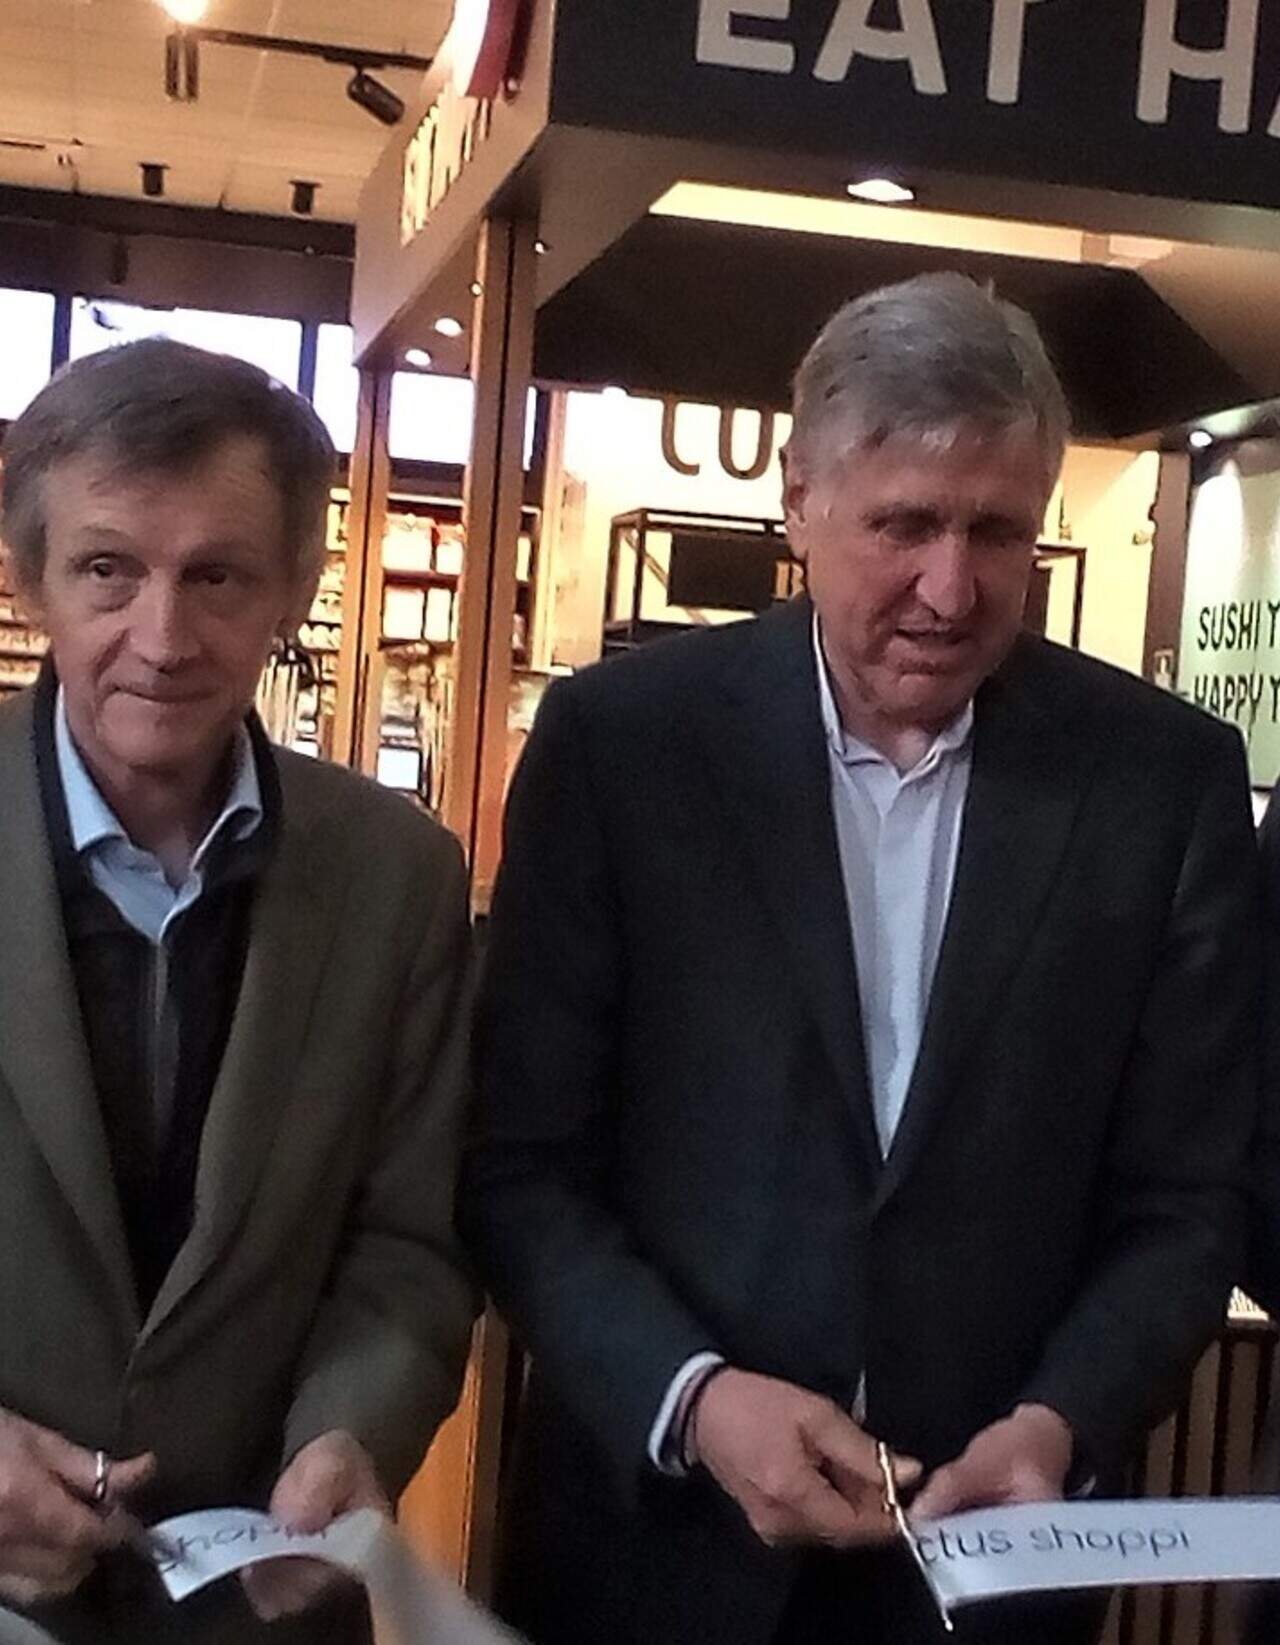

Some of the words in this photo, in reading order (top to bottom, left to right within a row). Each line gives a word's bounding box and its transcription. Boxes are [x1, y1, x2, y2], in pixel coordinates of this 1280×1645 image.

[1197, 600, 1261, 651] SUSHI
[1194, 672, 1263, 724] HAPPY
[1030, 1522, 1190, 1558] shoppi
